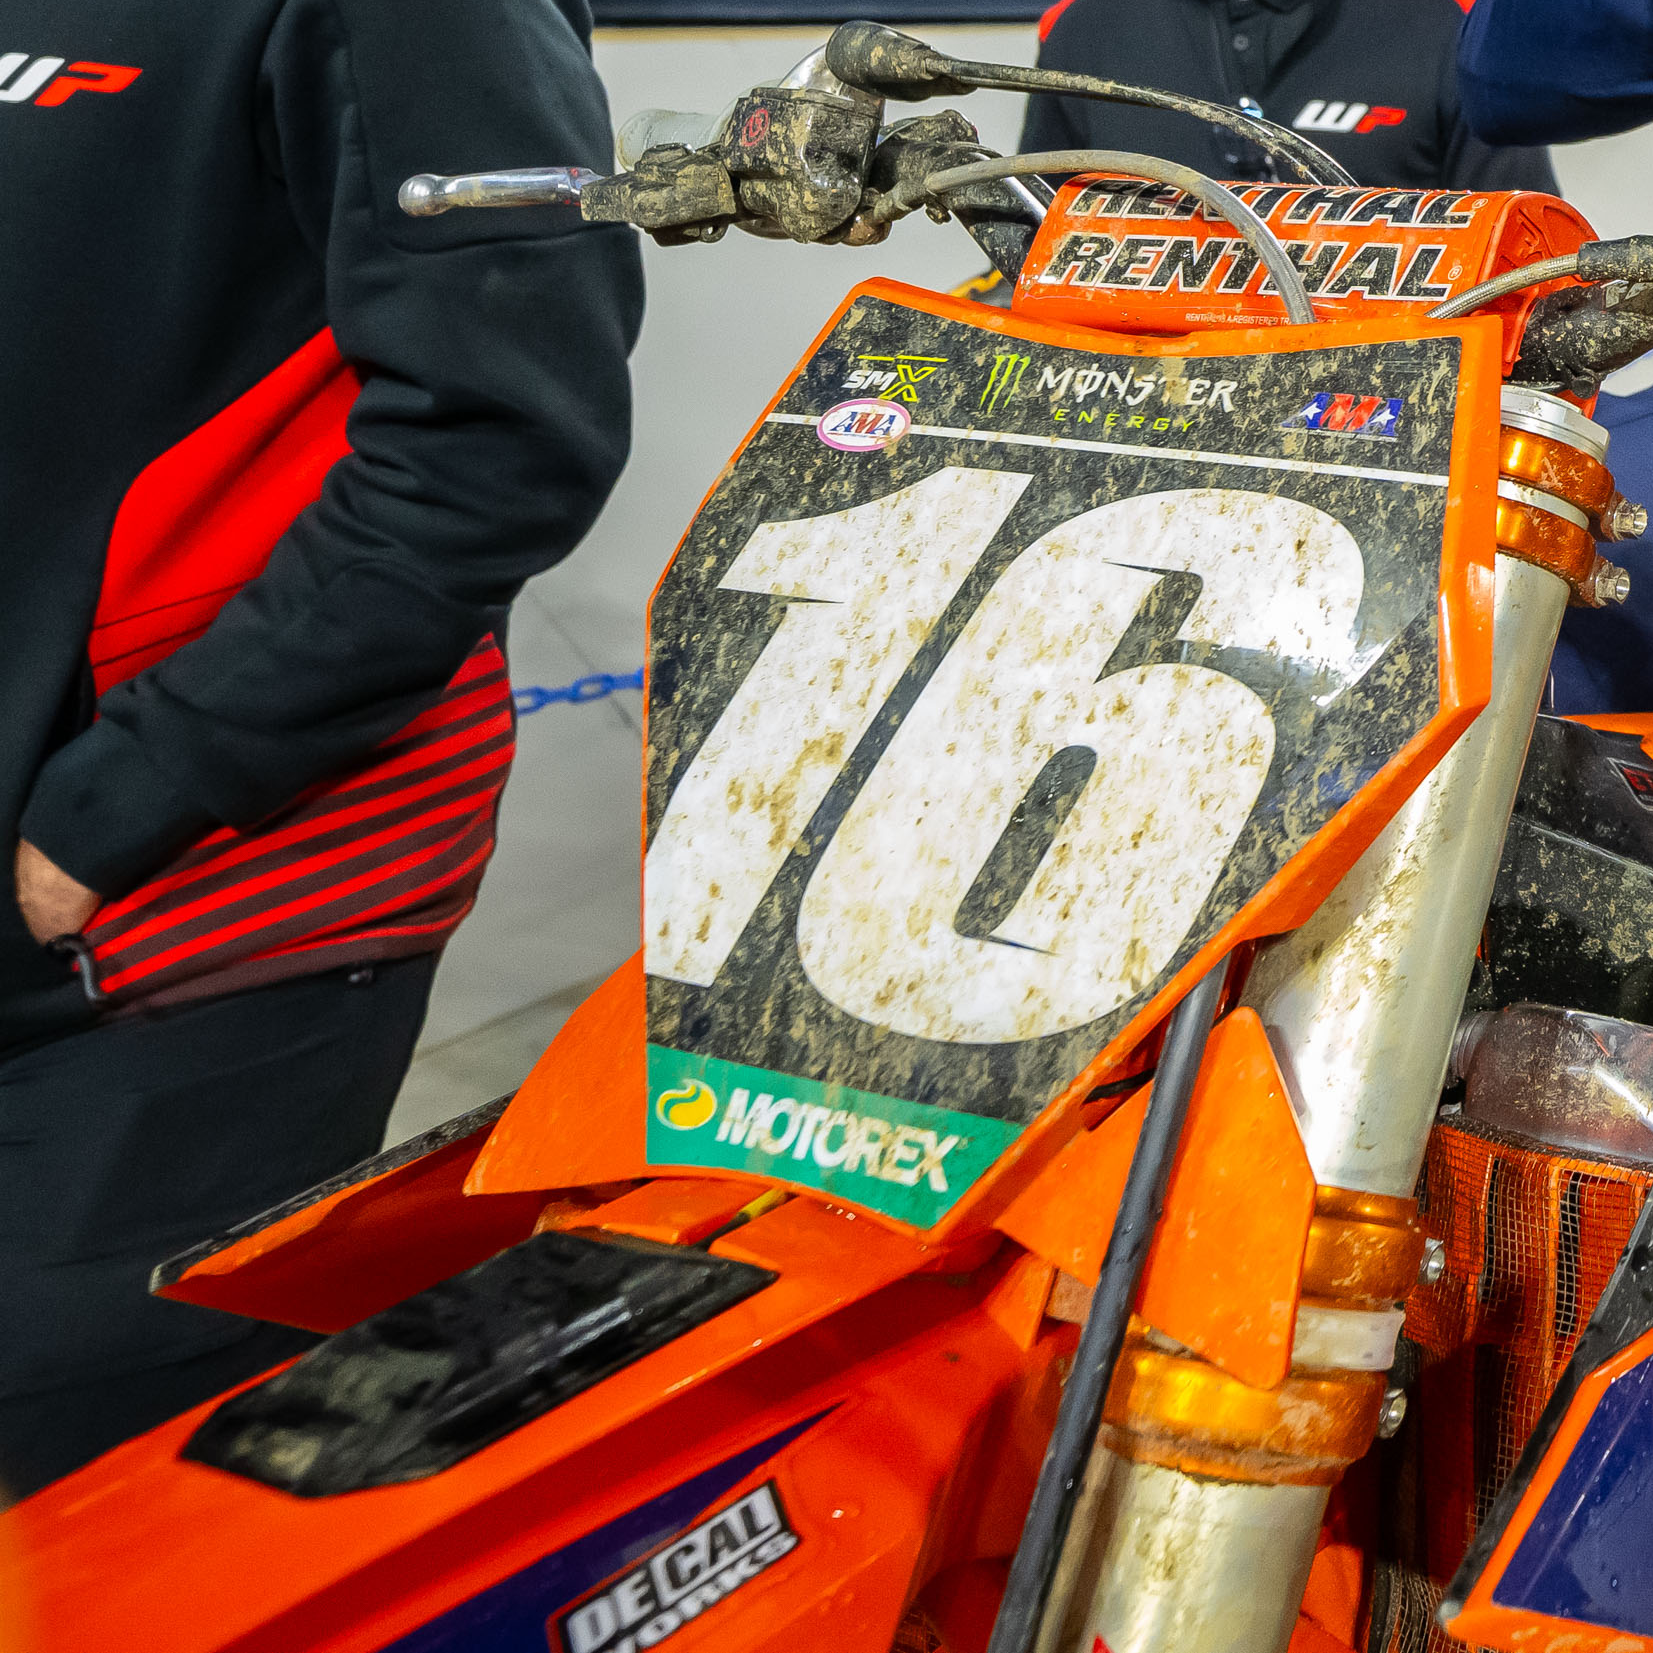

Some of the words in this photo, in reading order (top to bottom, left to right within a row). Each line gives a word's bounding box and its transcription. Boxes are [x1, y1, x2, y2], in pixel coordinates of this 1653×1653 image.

[1293, 99, 1407, 135] WP
[1065, 177, 1476, 230] RENTHAL
[1037, 231, 1453, 303] RENTHAL
[841, 364, 938, 403] SMX
[829, 411, 897, 436] AMA
[1053, 408, 1197, 434] ENERGY
[1280, 392, 1404, 437] AMA
[643, 464, 1368, 1046] 16
[714, 1087, 968, 1194] MOTOREX
[565, 1483, 783, 1653] DECAL
